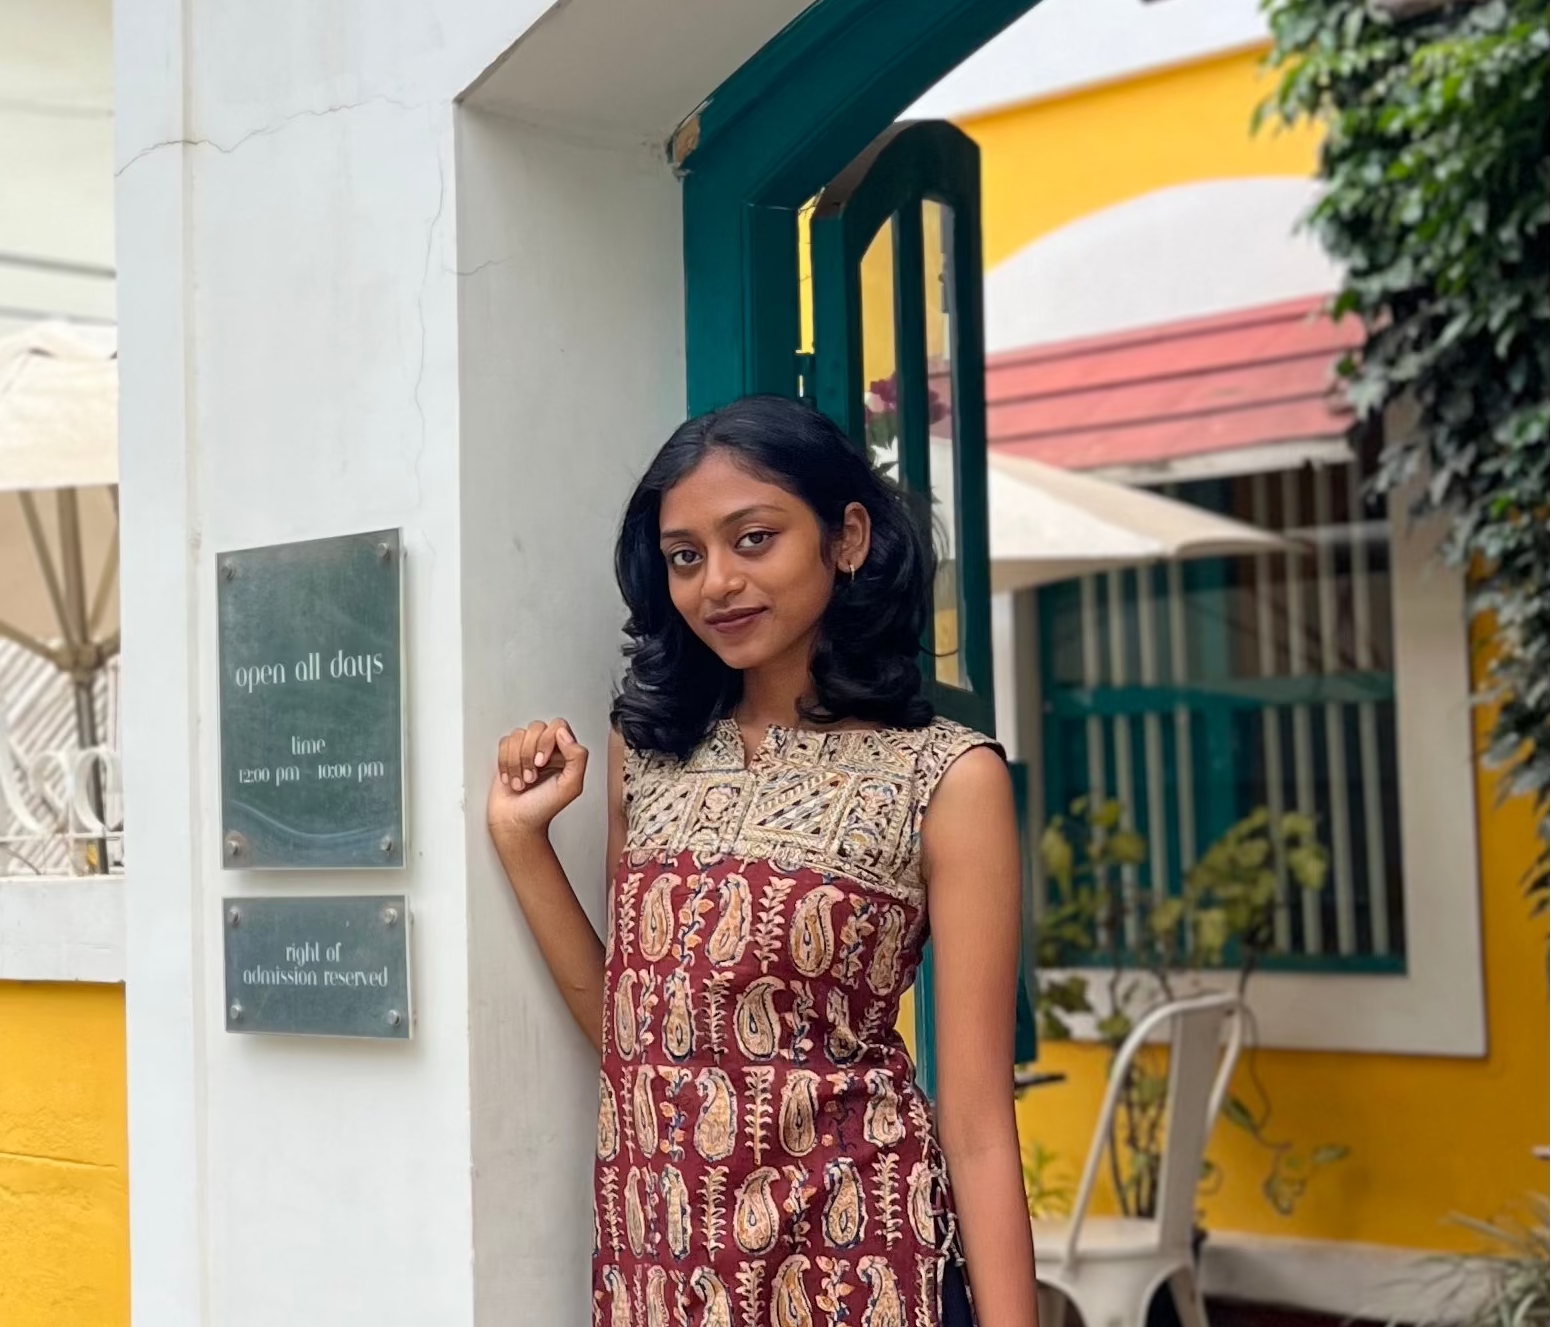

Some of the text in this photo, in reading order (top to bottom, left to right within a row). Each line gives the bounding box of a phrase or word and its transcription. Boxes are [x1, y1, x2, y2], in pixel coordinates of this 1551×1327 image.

[236, 649, 384, 693] open all days
[239, 760, 385, 787] 12:00 pm 10:00 pm
[285, 941, 342, 966] right of
[243, 965, 388, 987] admission reserved
